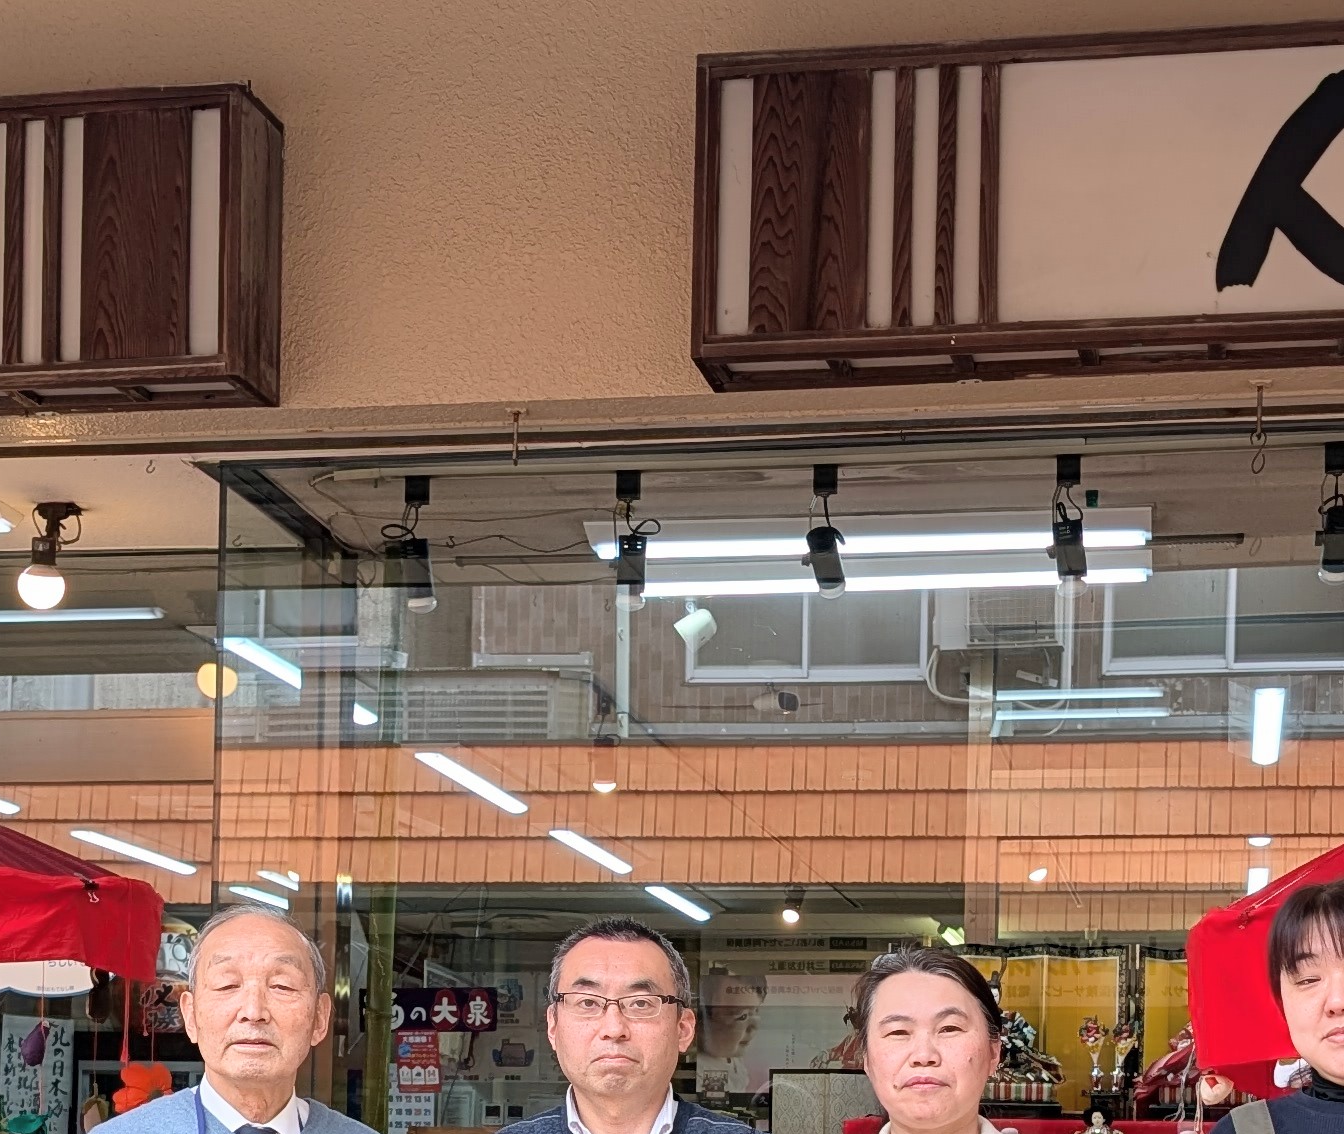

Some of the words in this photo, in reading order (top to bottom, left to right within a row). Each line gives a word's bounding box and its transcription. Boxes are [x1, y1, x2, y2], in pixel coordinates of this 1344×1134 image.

[414, 1095, 422, 1103] 13
[423, 1095, 431, 1103] 14
[395, 1108, 403, 1116] 18
[394, 1121, 403, 1129] 25
